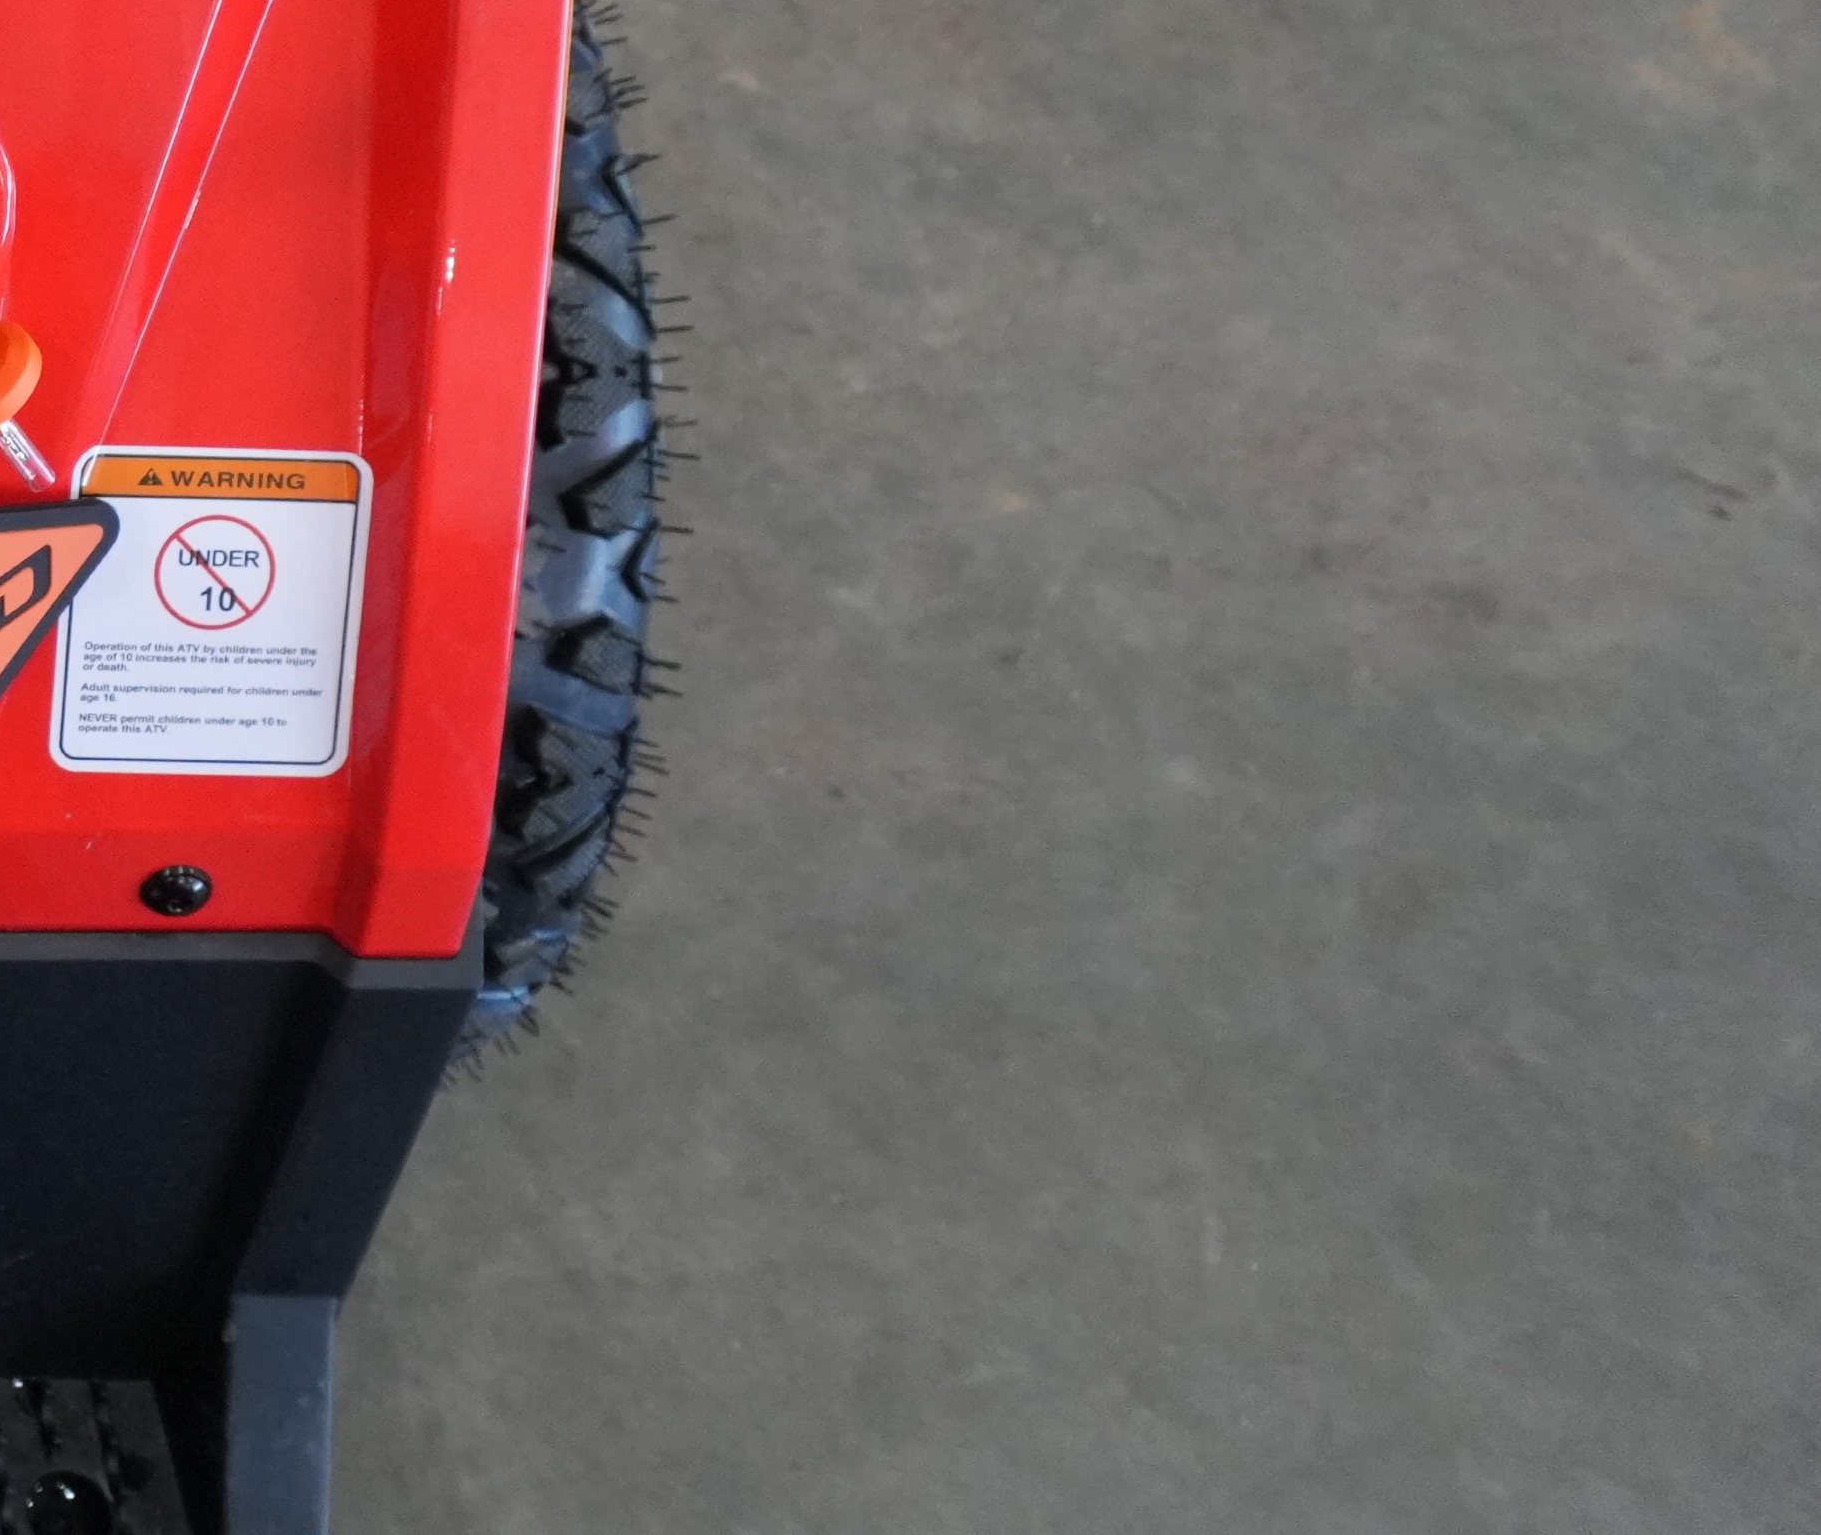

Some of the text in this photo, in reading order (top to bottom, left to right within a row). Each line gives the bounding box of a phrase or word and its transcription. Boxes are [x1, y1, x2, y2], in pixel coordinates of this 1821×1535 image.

[170, 470, 306, 490] WARNING
[178, 548, 260, 568] UNDER
[200, 586, 236, 612] 10
[85, 641, 297, 655] Operation this ATV children under
[84, 653, 102, 662] age
[120, 653, 133, 661] 10
[135, 653, 187, 663] increases
[191, 655, 207, 663] the
[210, 655, 230, 663] risk
[286, 657, 316, 667] injury
[81, 682, 323, 697] Adult supervision required children under
[80, 694, 99, 703] age
[79, 713, 236, 725] NEVER permit children under
[78, 725, 140, 733] operate this
